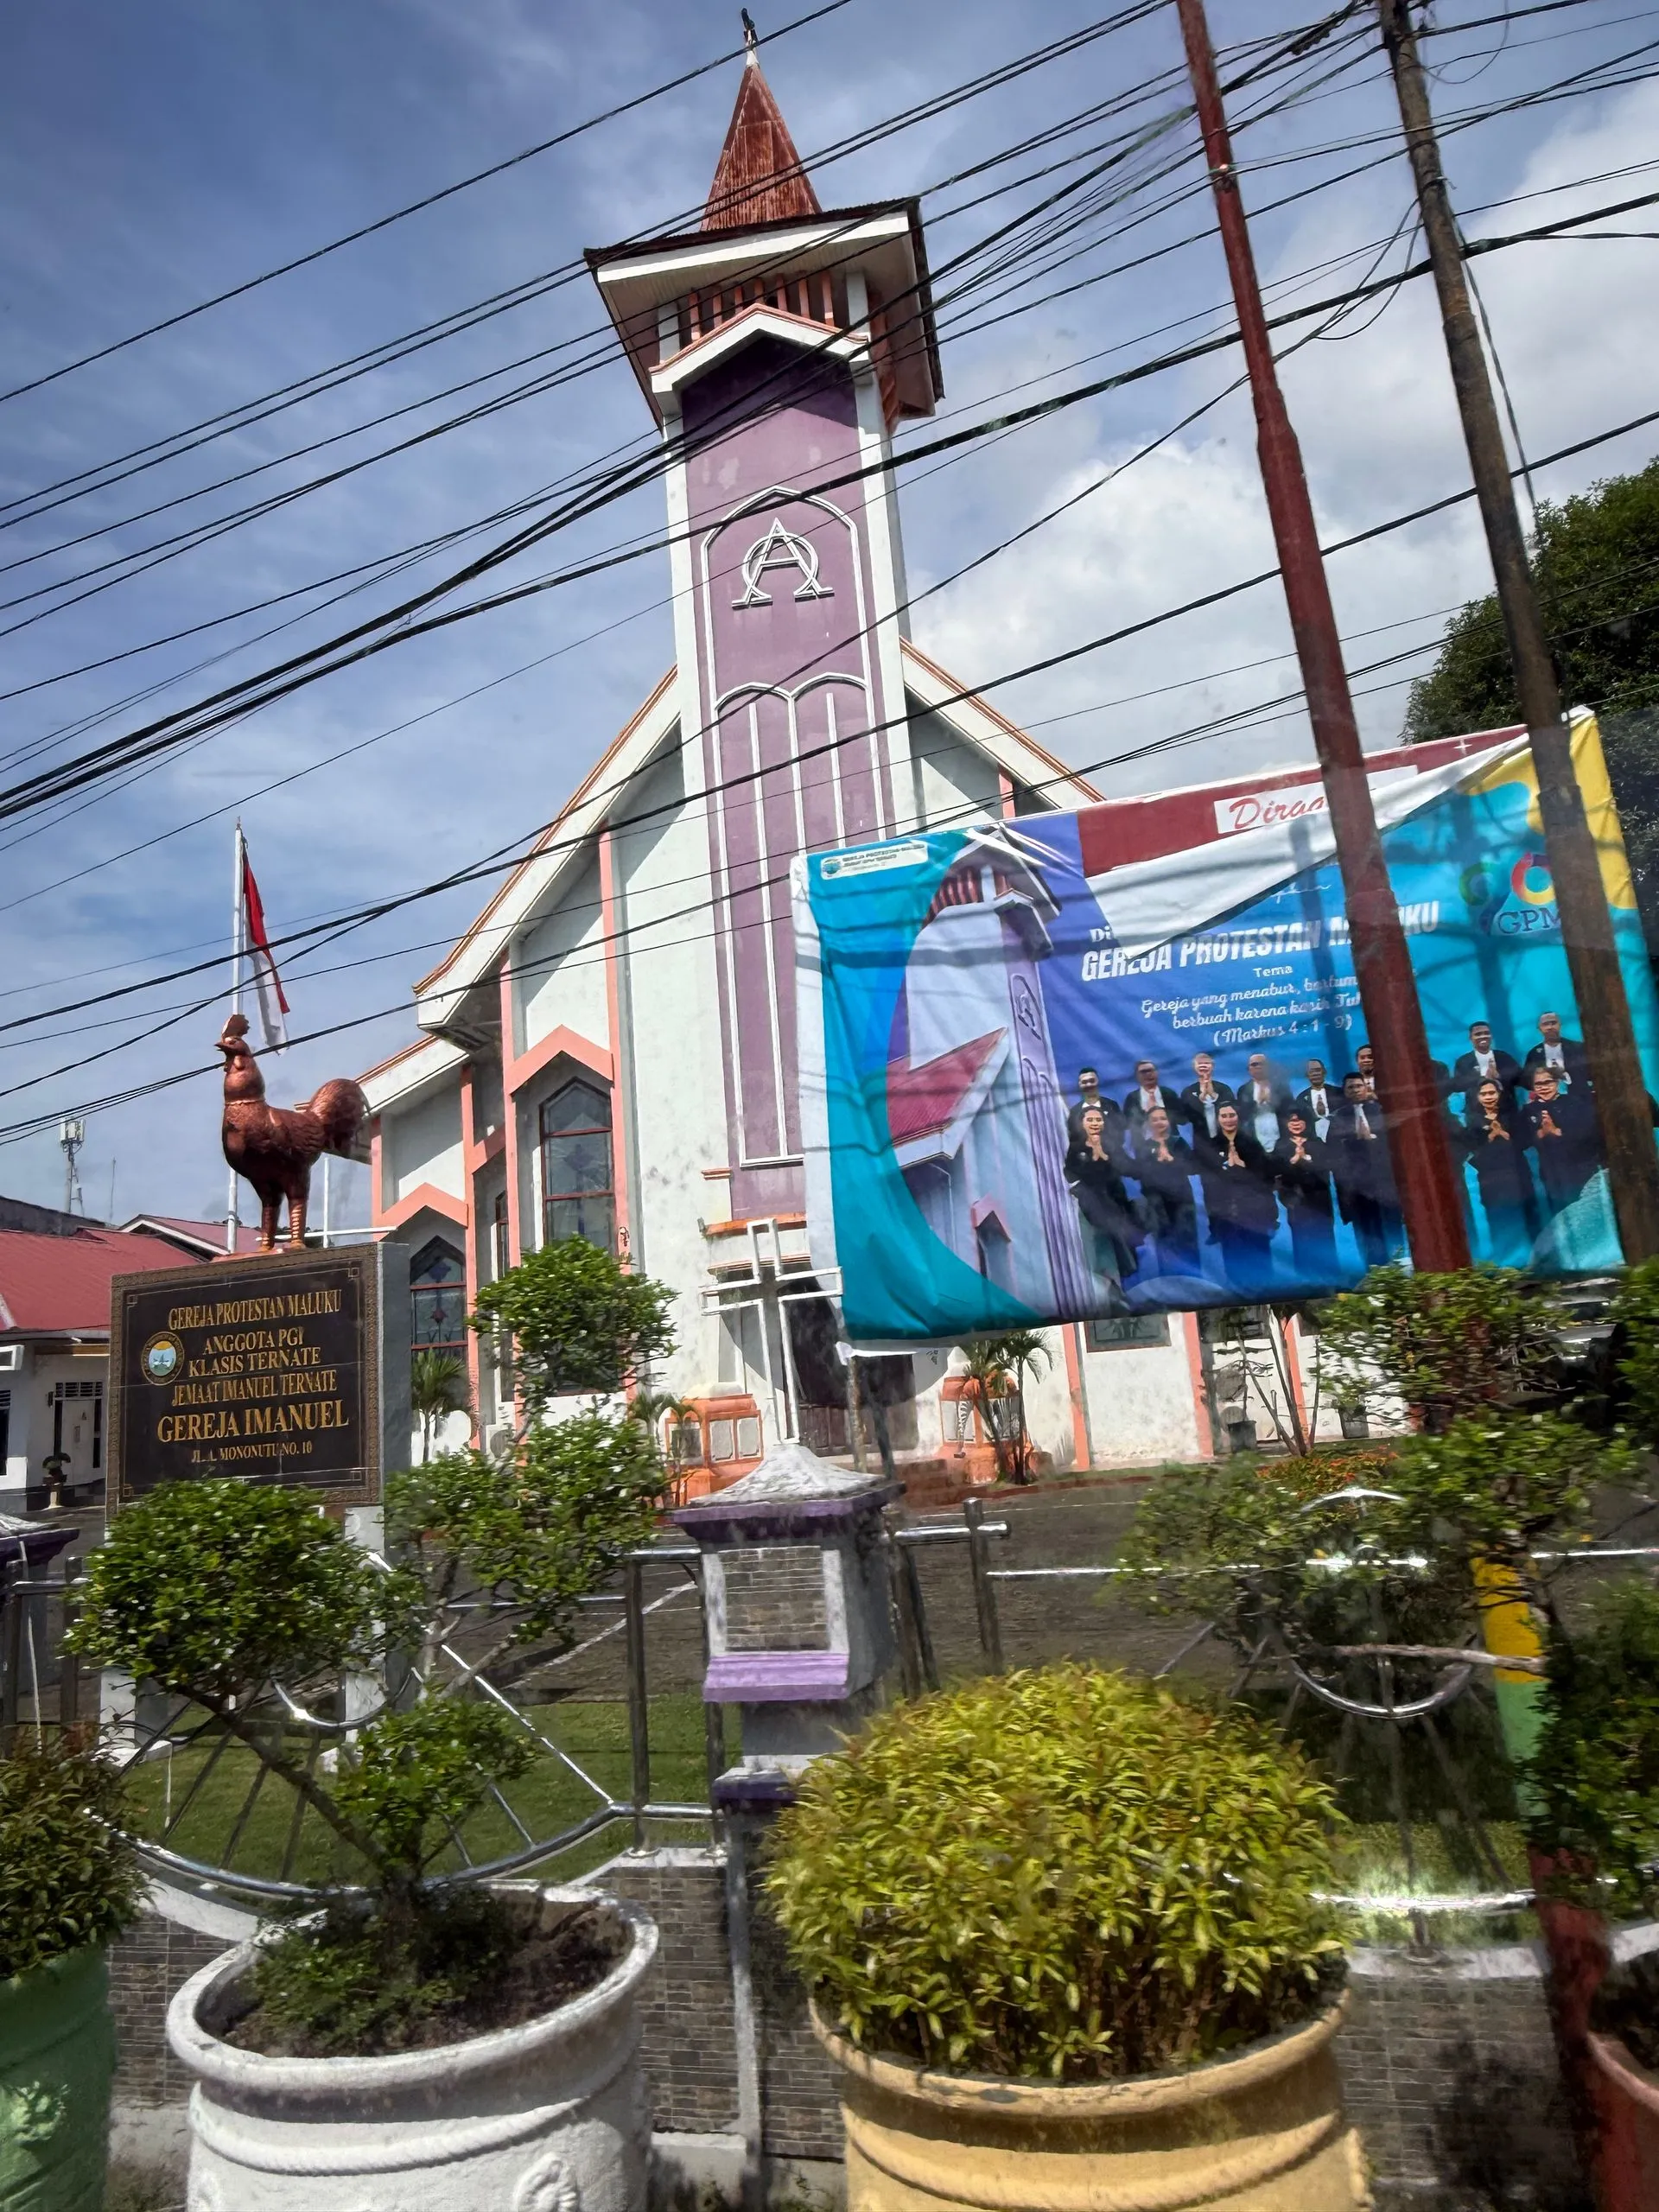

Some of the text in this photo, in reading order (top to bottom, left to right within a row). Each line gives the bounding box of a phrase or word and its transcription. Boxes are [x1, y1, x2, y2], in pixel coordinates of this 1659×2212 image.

[1090, 925, 1112, 943] Di
[1179, 920, 1321, 968] PROTESTAN
[1141, 997, 1190, 1019] Gereja
[1192, 993, 1228, 1011] yang
[1173, 1008, 1233, 1029] berbuah
[1236, 1006, 1287, 1021] karena
[168, 1289, 342, 1331] GEREJA PROTESTAN MALUKU
[202, 1331, 276, 1356] ANGGOTA
[188, 1358, 244, 1378] KLASIS
[246, 1346, 321, 1372] TERNATE
[172, 1382, 221, 1407] JEMAAT
[279, 1369, 338, 1396] TERNATE
[157, 1399, 349, 1443] GEREJA IMANUEL
